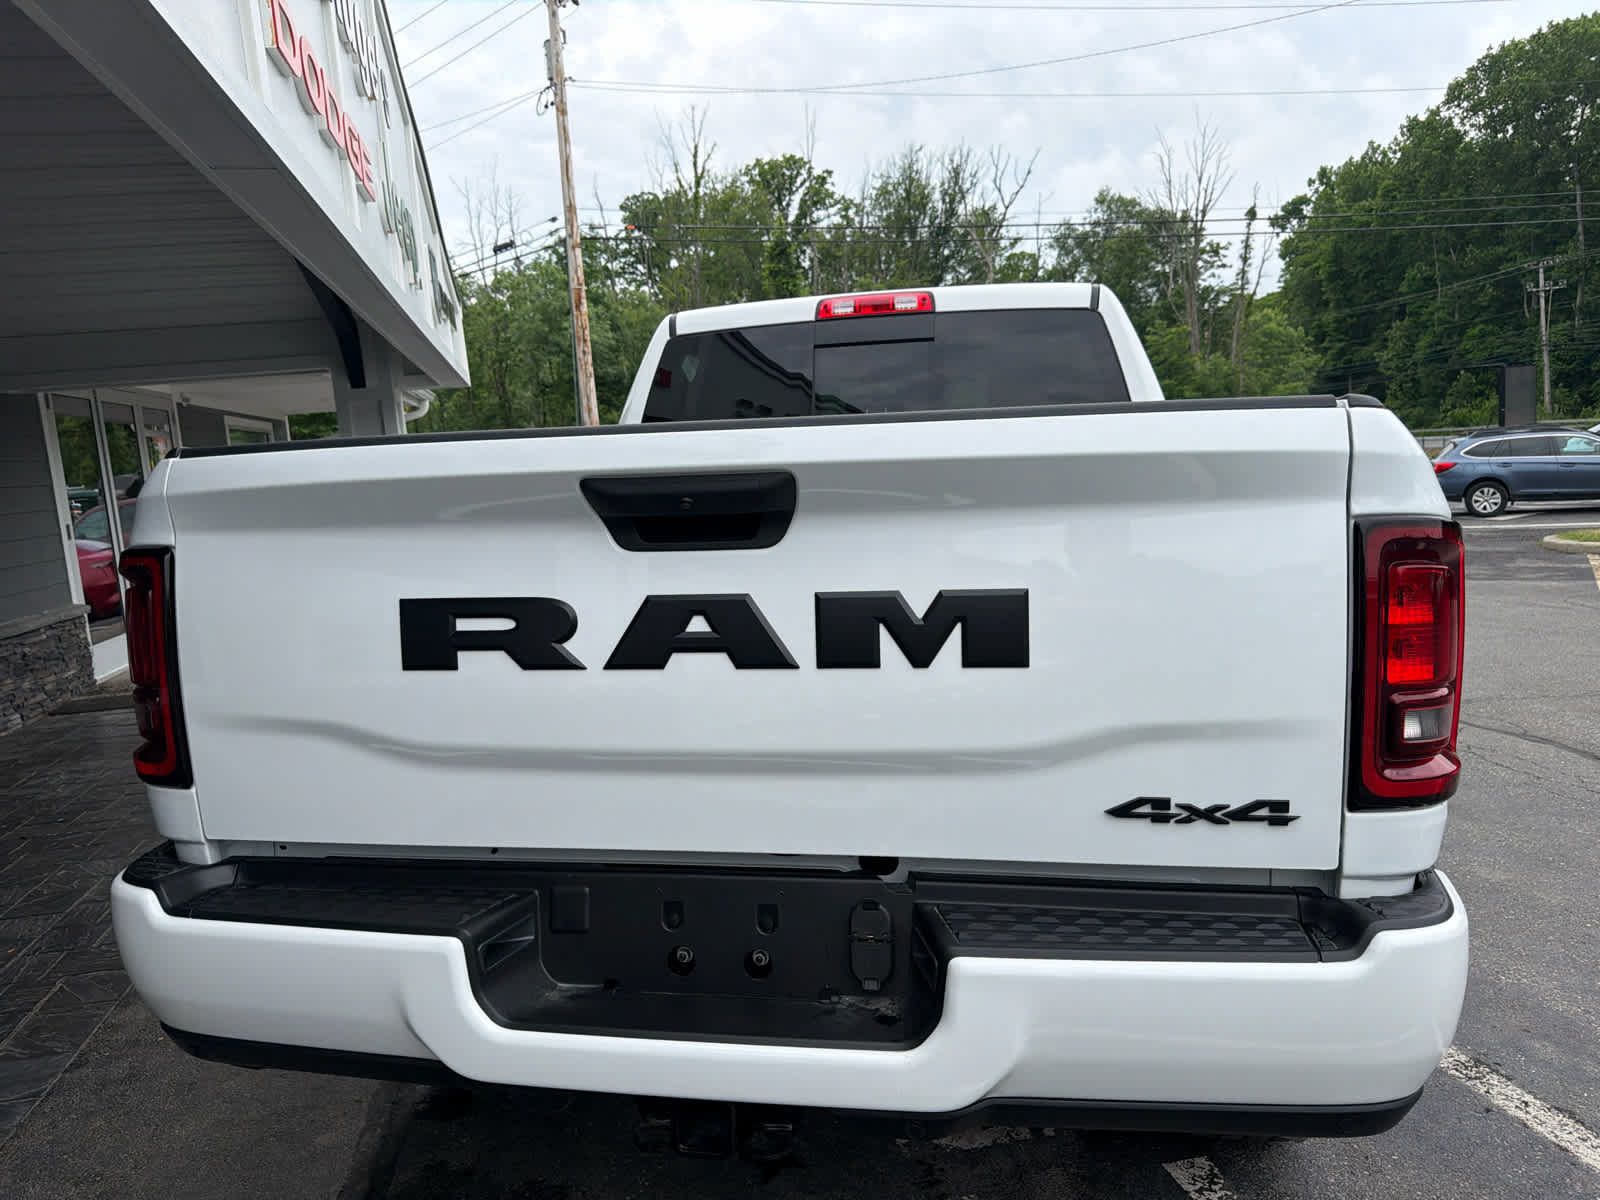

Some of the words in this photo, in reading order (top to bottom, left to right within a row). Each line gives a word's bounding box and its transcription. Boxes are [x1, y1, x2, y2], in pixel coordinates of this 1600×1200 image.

[266, 0, 376, 203] DODGE
[400, 588, 1031, 671] RAM
[1104, 796, 1302, 827] 4x4
